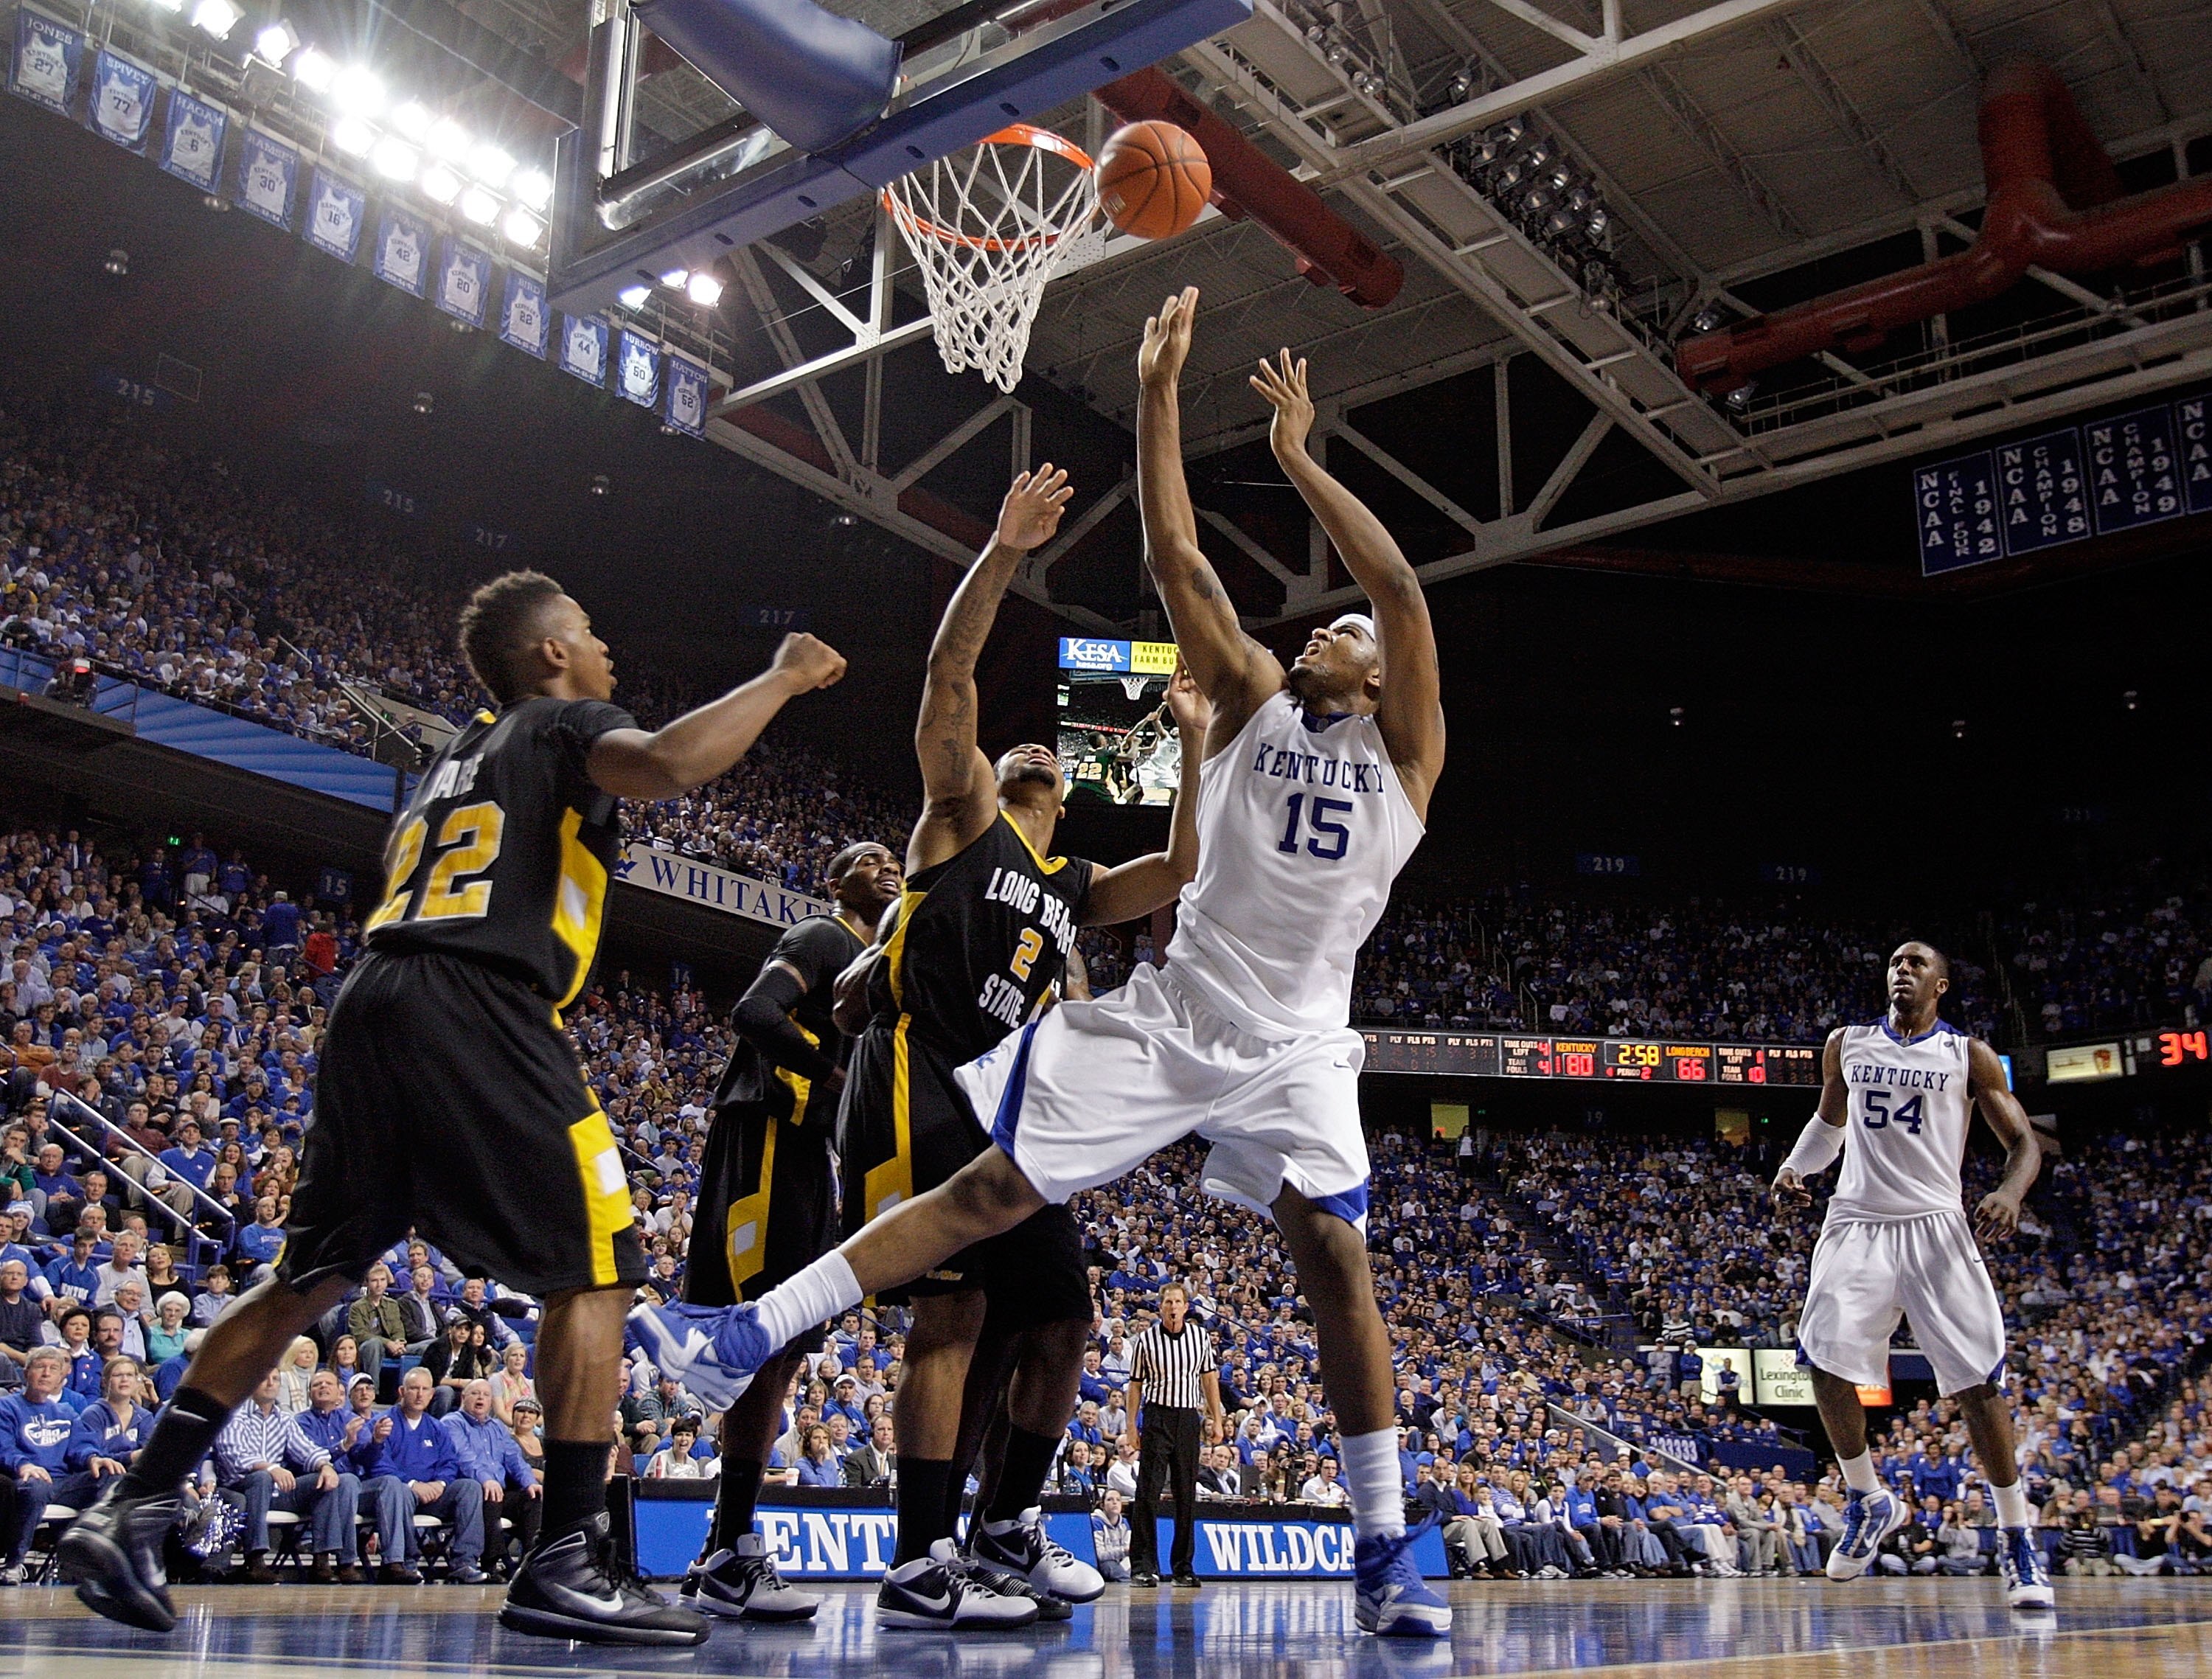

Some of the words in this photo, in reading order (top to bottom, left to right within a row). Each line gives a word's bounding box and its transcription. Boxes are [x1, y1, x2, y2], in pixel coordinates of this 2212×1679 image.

[27, 17, 73, 45] JONES
[34, 58, 54, 75] 27
[105, 58, 150, 86] SPIVEY
[113, 96, 131, 114] 77
[176, 95, 223, 127] HAGAN
[260, 175, 276, 192] 30
[327, 211, 341, 226] 16
[396, 248, 411, 263] 42
[456, 278, 470, 293] 20
[518, 277, 541, 295] BIRD
[520, 310, 533, 325] 22
[578, 341, 590, 355] 44
[633, 366, 646, 380] 50
[672, 360, 708, 384] HATTON
[681, 394, 694, 409] 52
[2183, 401, 2211, 482] NCAA
[2092, 427, 2121, 505] NCAA
[2123, 423, 2151, 514] CHAMPION
[2151, 437, 2176, 512] 1949
[1948, 470, 1964, 514] FINAL
[2003, 448, 2028, 525] NCAA
[2033, 446, 2057, 537] CHAMPION
[2061, 458, 2085, 533] 1948
[1921, 472, 1944, 547] NCAA
[1974, 480, 1995, 555] 1942
[1953, 521, 1970, 557] FOUR
[759, 609, 795, 624] 217
[1066, 639, 1123, 663] KESA
[1135, 655, 1158, 664] FARM
[432, 753, 484, 799] ARE
[1076, 762, 1102, 780] 22
[1254, 743, 1384, 793] KENTUCKY
[1279, 792, 1352, 861] 15
[366, 801, 506, 931] 22
[1593, 857, 1624, 872] 219
[1775, 866, 1806, 880] 219
[324, 875, 347, 896] 15
[650, 855, 827, 925] WHITAKE
[985, 867, 1040, 914] LONG
[1040, 893, 1077, 959] BEAH
[1010, 927, 1043, 982] 2
[978, 973, 1025, 1029] STATE
[1364, 1034, 1377, 1043] PTS
[1389, 1035, 1402, 1044] PLY
[1407, 1035, 1420, 1044] FLS
[1422, 1036, 1436, 1045] PTS
[1447, 1037, 1461, 1046] PLY
[1465, 1038, 1479, 1046] FLS
[1480, 1039, 1494, 1047] PTS
[1503, 1040, 1520, 1048] TIME
[1520, 1040, 1538, 1049] OUTS
[1556, 1042, 1596, 1053] KENTUCKY
[2159, 1031, 2208, 1066] 34
[1512, 1048, 1529, 1056] LEFT
[1618, 1044, 1660, 1066] 2:58
[1666, 1046, 1686, 1057] LONG
[1686, 1047, 1710, 1057] BEACH
[1718, 1047, 1735, 1056] TIME
[1735, 1048, 1752, 1057] OUTS
[1727, 1056, 1743, 1064] LEFT
[1768, 1049, 1781, 1058] PLY
[1785, 1049, 1798, 1058] FLS
[1799, 1050, 1813, 1059] PTS
[1506, 1066, 1528, 1074] FOULS
[1508, 1058, 1526, 1066] TEAM
[1537, 1060, 1551, 1074] 4
[1565, 1054, 1593, 1076] 80
[1677, 1057, 1705, 1080] 66
[1722, 1066, 1741, 1074] TEAM
[1616, 1068, 1641, 1077] PERIOD
[1641, 1066, 1652, 1080] 2
[1721, 1073, 1743, 1082] FOULS
[1850, 1065, 1950, 1092] KENTUCKY
[1863, 1090, 1923, 1135] 54
[1774, 1386, 1804, 1399] Clinic
